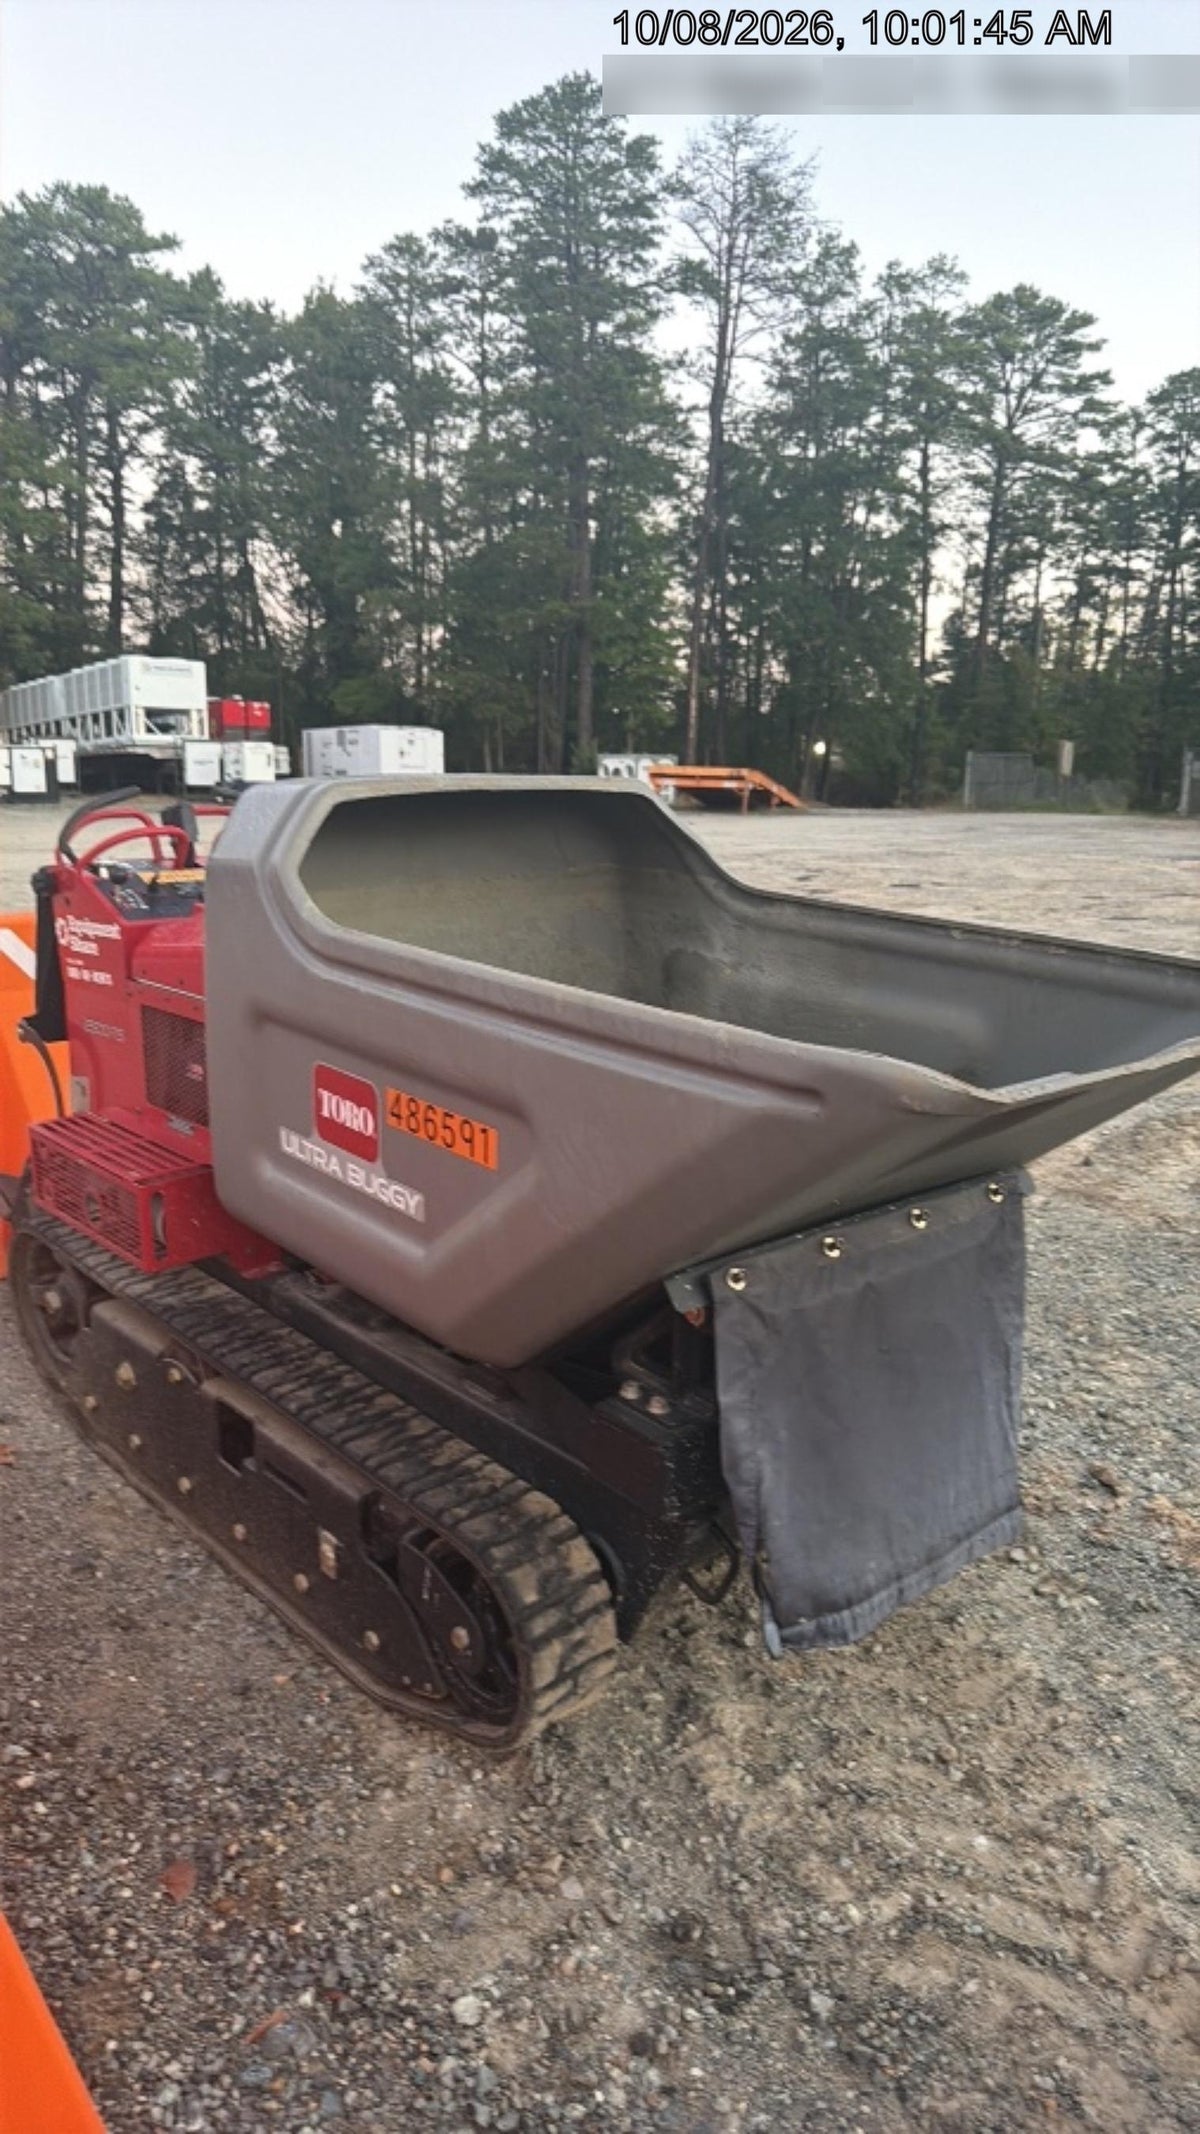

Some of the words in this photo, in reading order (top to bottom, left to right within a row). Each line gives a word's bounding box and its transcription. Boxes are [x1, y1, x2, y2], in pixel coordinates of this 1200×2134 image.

[317, 1087, 375, 1137] TORO
[389, 1093, 490, 1165] 486591
[280, 1127, 343, 1181] ULTRA
[348, 1162, 424, 1216] BUGGY
